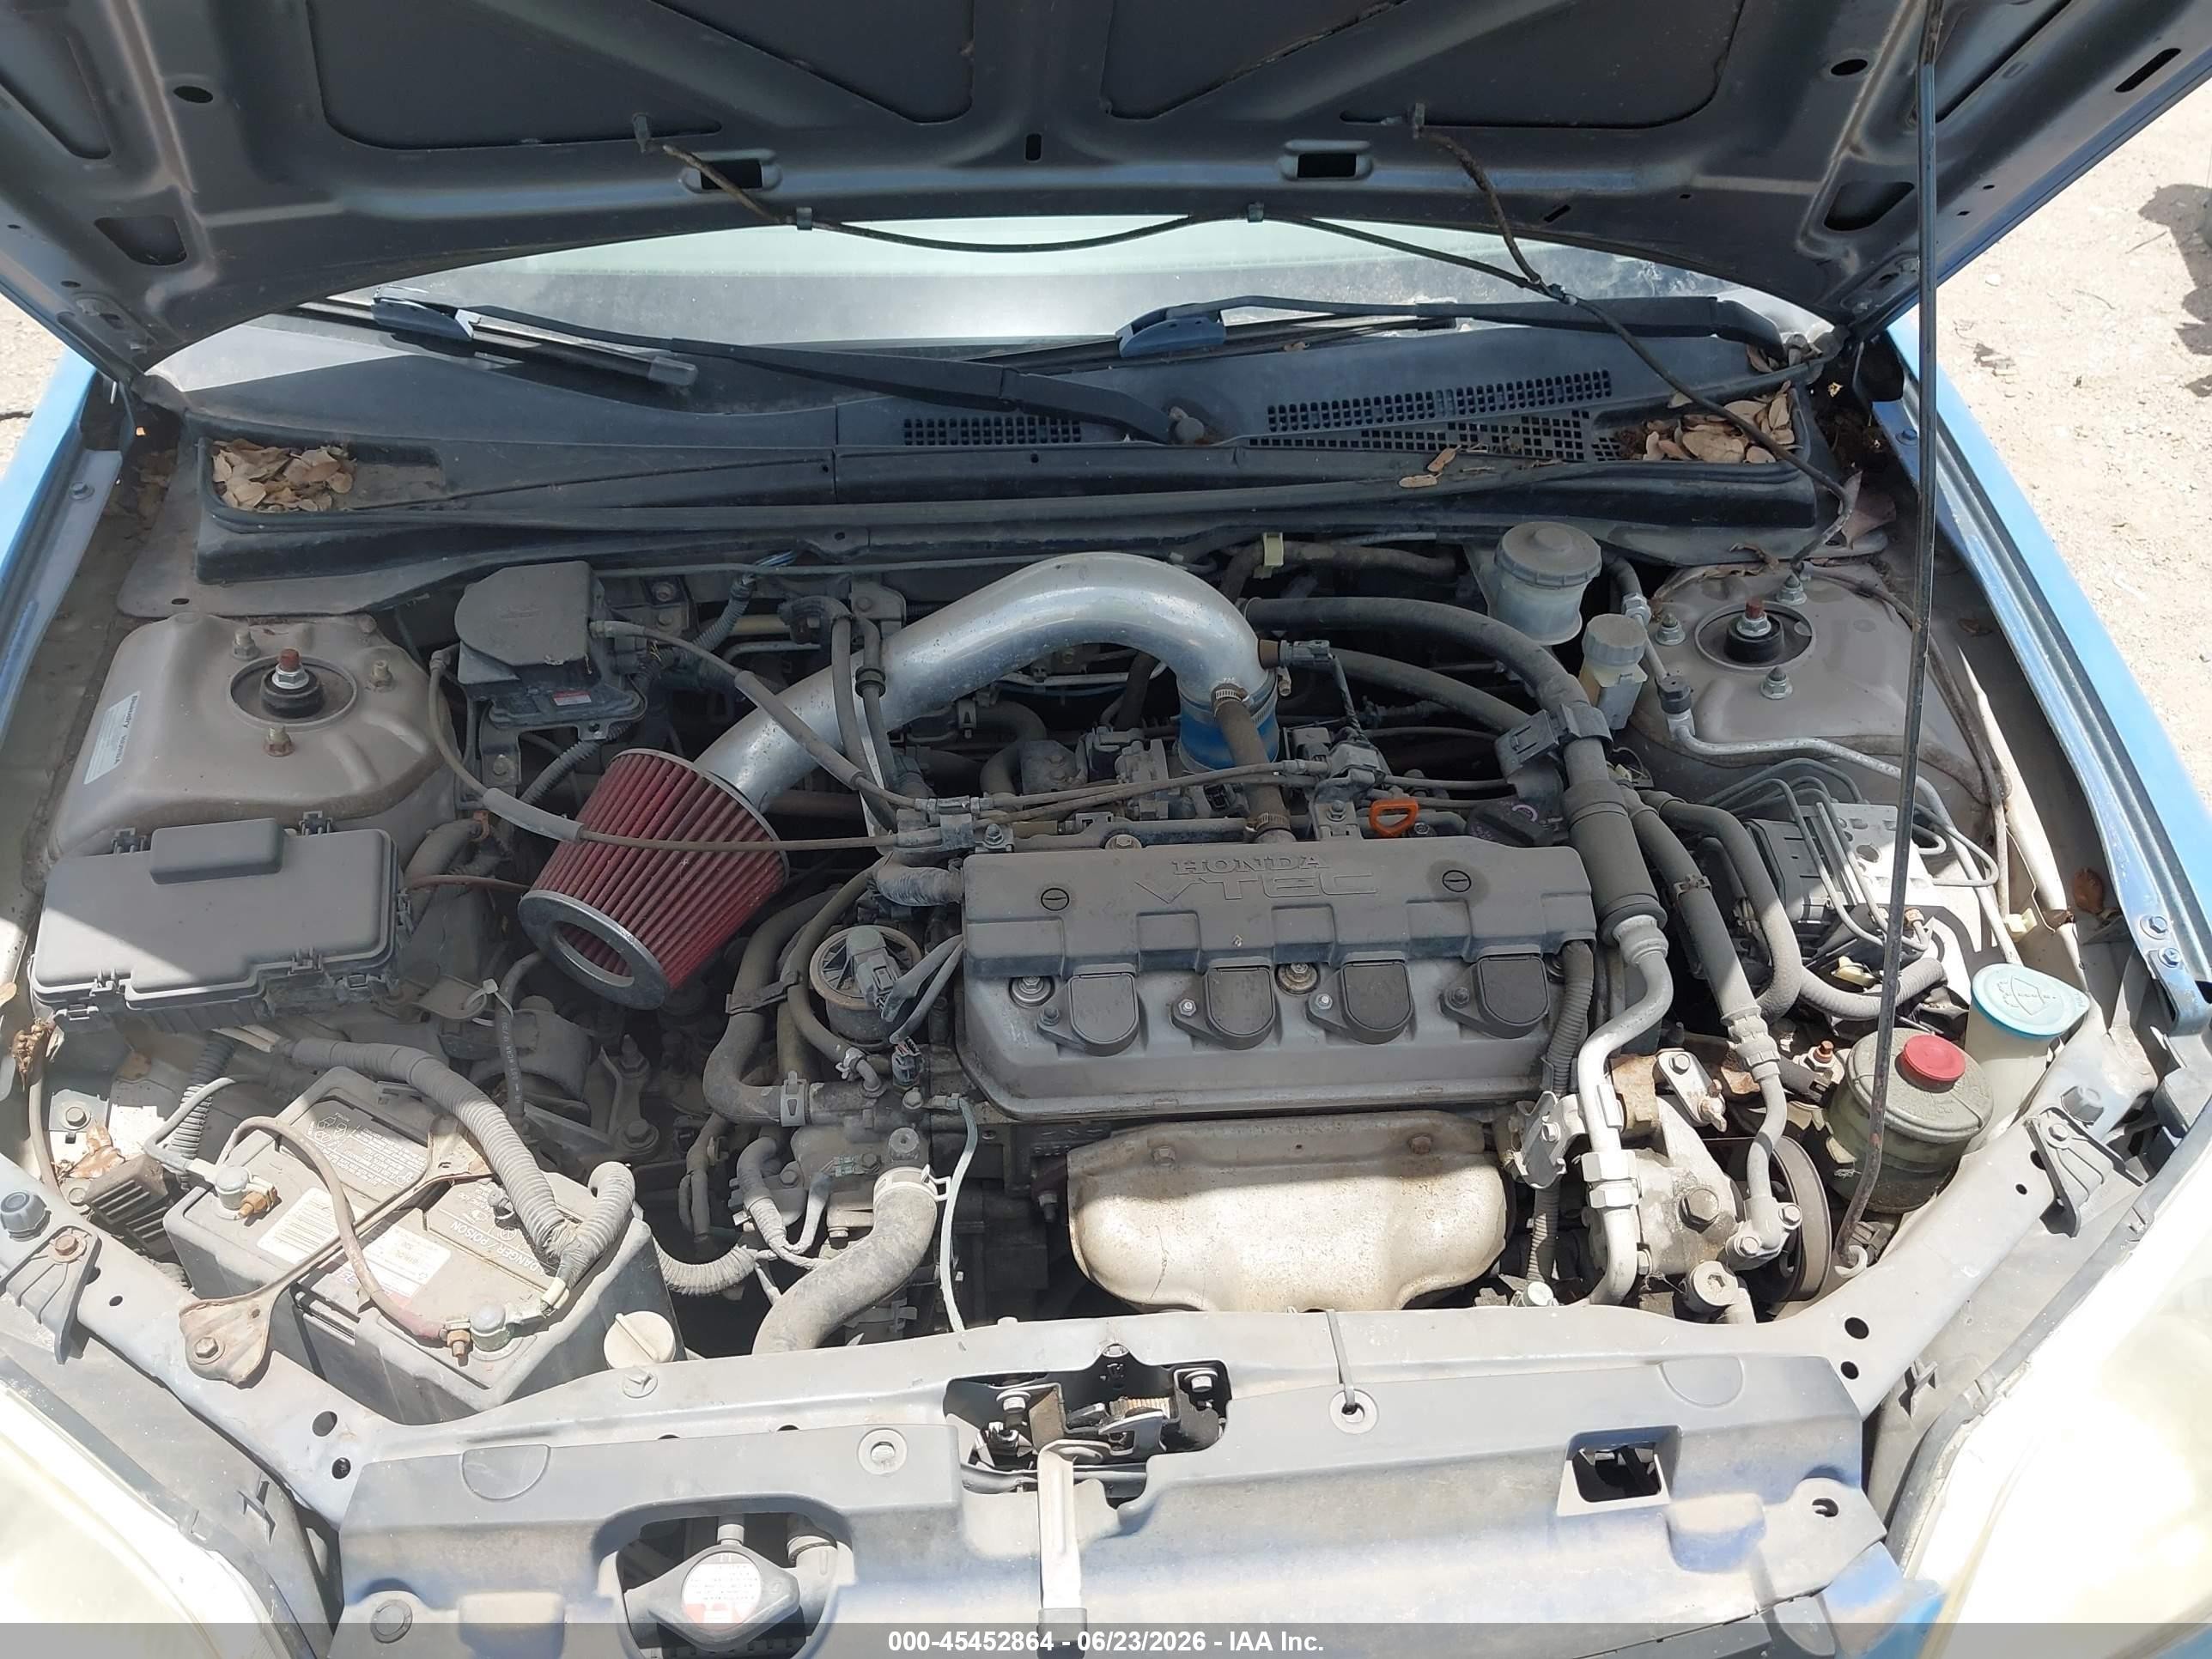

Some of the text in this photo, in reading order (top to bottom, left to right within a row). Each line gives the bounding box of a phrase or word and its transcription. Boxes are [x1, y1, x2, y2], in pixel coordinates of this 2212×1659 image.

[1172, 856, 1330, 876] HONDA
[1134, 873, 1377, 904] VTEC
[450, 1220, 489, 1246] POISON
[496, 1243, 540, 1272] DANGER
